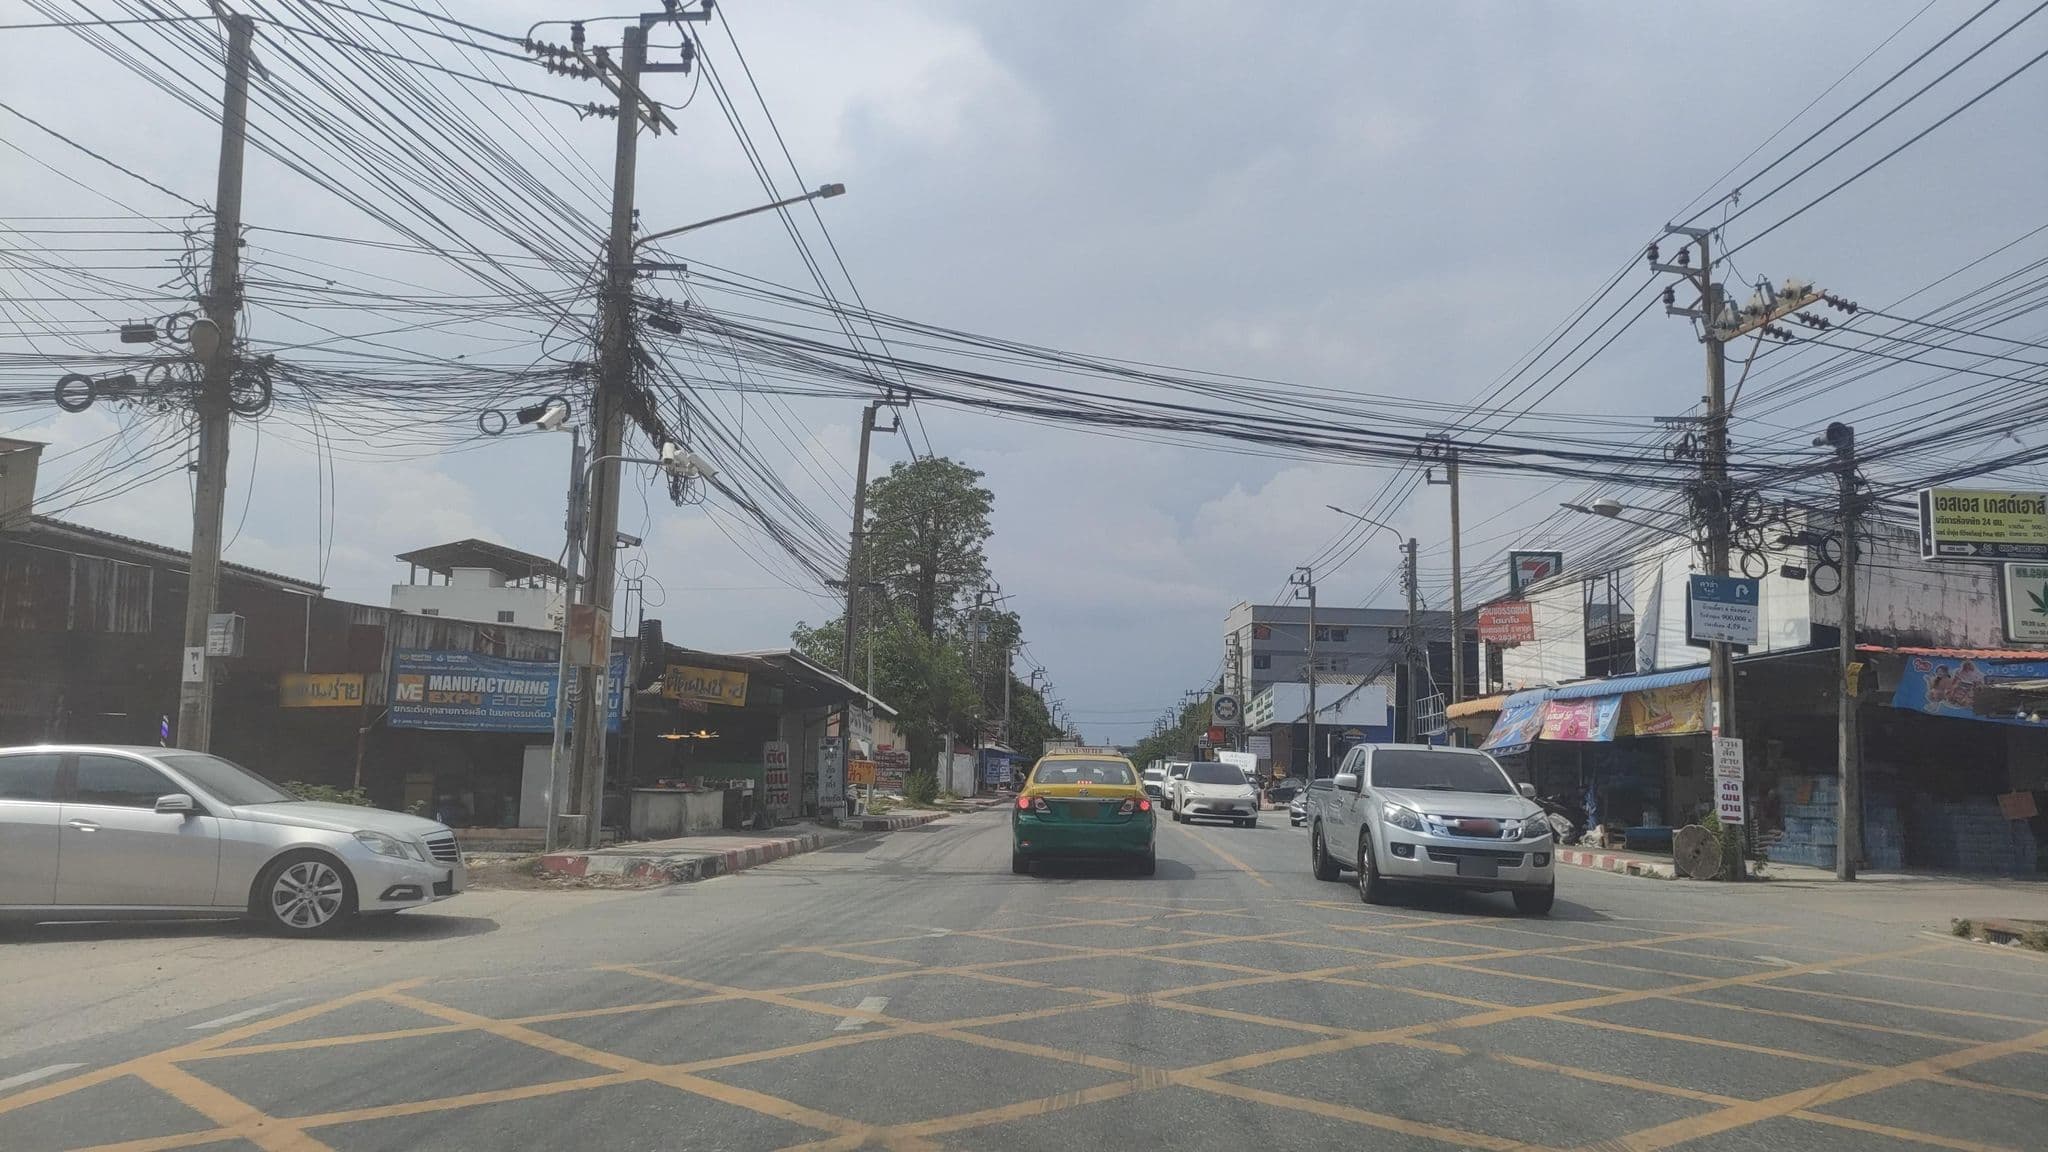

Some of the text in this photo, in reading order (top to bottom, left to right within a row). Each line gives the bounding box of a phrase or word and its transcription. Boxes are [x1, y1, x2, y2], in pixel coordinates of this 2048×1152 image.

[1936, 496, 1979, 512] เอสเอส
[1982, 518, 1991, 526] 24
[429, 675, 549, 695] MANUFACTURING
[429, 691, 547, 706] EXPO 2025
